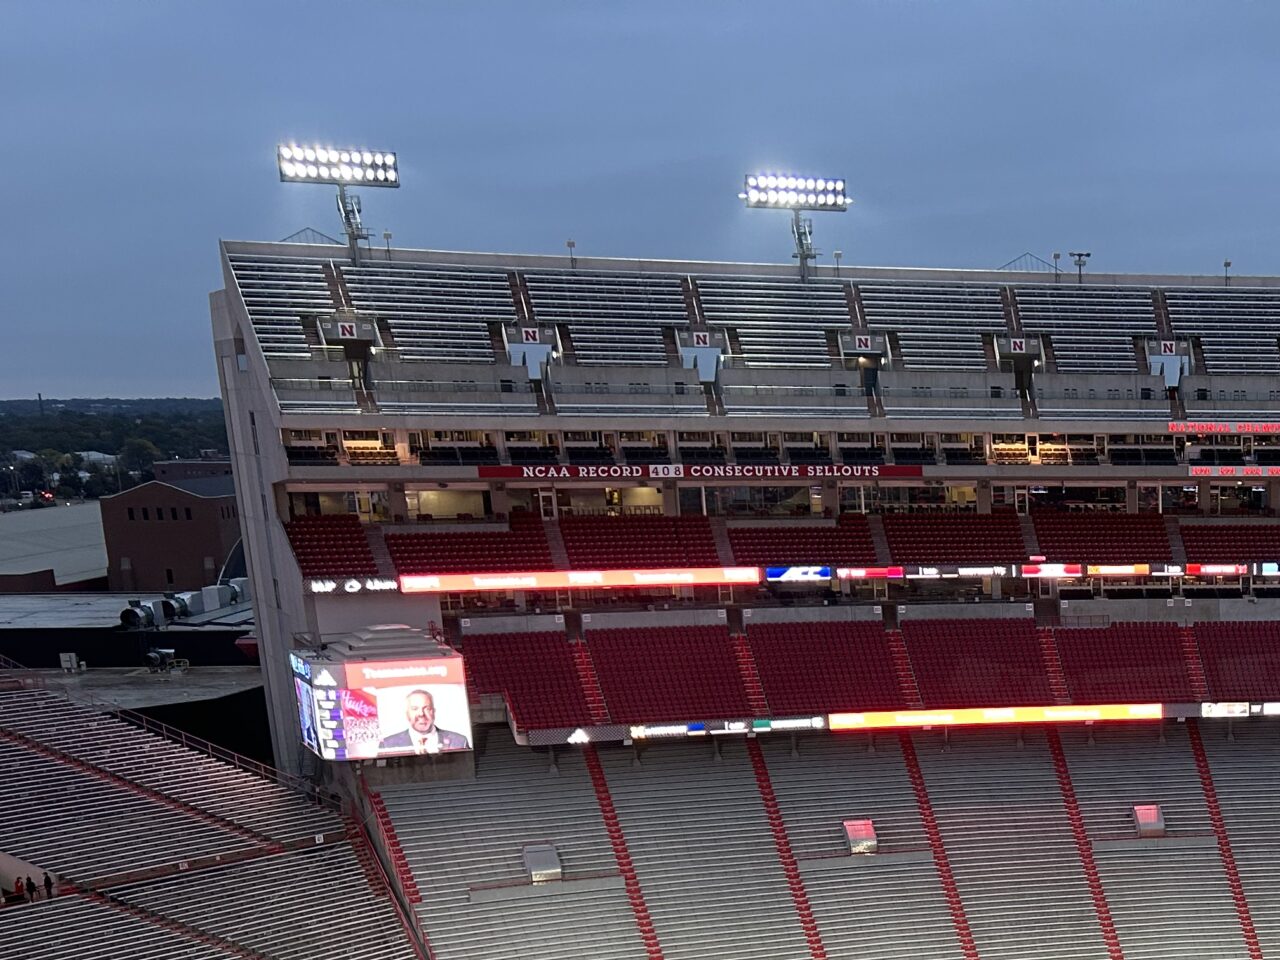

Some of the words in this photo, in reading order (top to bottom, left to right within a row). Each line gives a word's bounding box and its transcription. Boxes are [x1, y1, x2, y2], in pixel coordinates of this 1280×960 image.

[340, 324, 354, 336] N
[524, 330, 539, 341] N
[696, 334, 708, 344] N
[856, 337, 870, 348] N
[1012, 340, 1024, 351] N
[1163, 342, 1175, 353] N
[1168, 422, 1231, 432] NATIONAL
[522, 467, 570, 477] NCAA
[578, 467, 642, 477] RECORD
[651, 466, 682, 476] 408
[690, 467, 799, 477] CONSECUTIVE
[808, 467, 879, 477] SELLOUTS
